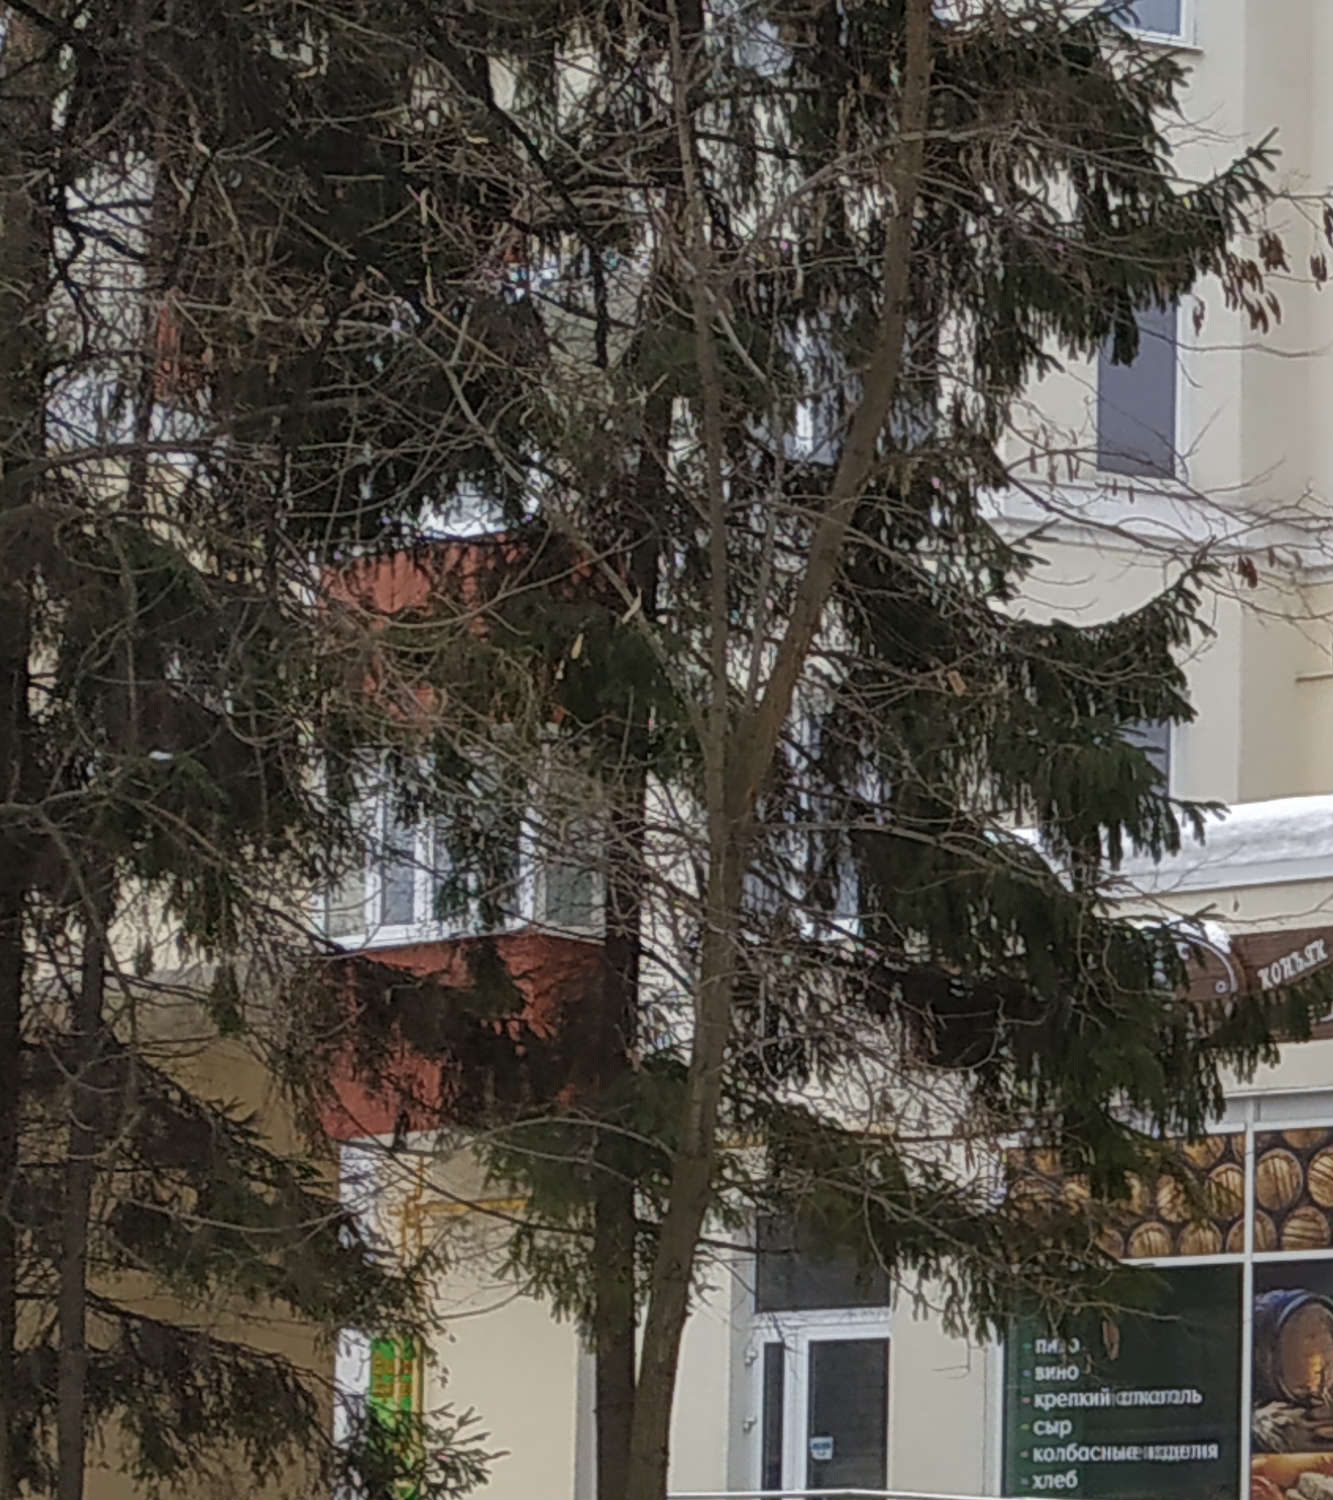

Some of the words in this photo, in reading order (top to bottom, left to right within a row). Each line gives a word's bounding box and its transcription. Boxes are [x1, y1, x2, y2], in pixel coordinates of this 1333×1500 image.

[1257, 939, 1329, 990] КОНЬЯК
[1034, 1338, 1081, 1354] пио
[1034, 1365, 1080, 1381] вино
[1034, 1386, 1111, 1411] крепкий
[1033, 1419, 1072, 1439] сыр
[1032, 1442, 1141, 1462] колбасные
[1031, 1469, 1079, 1489] хлеб
